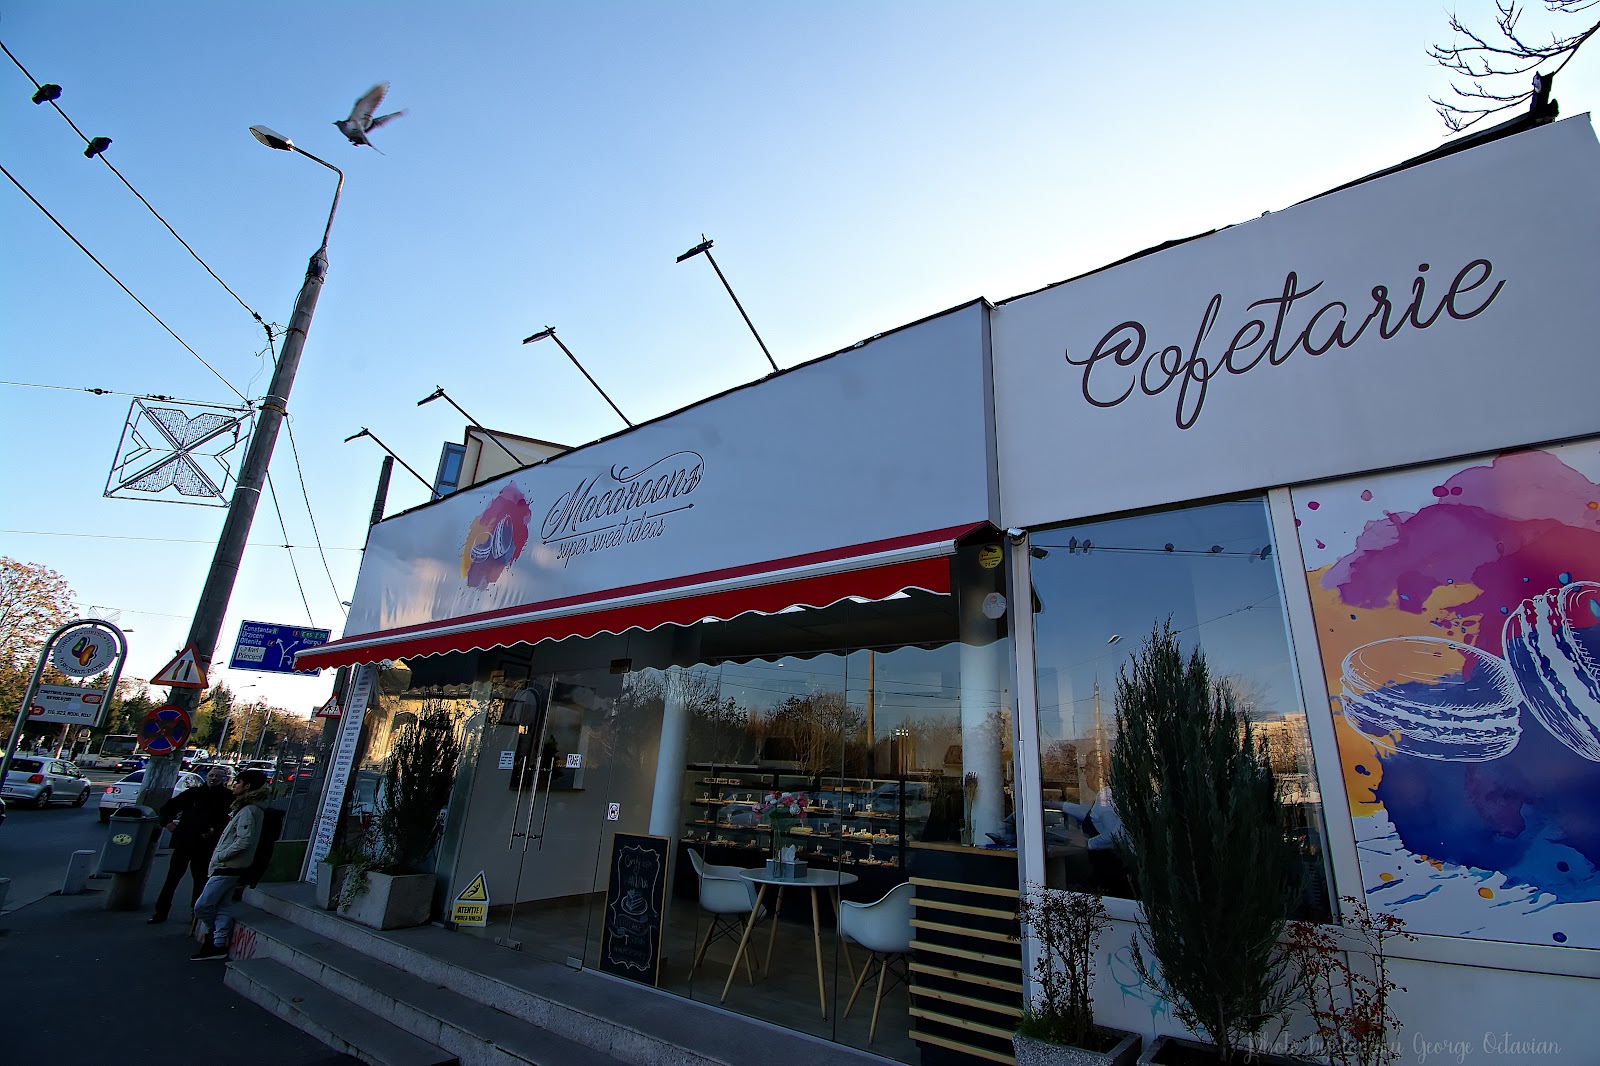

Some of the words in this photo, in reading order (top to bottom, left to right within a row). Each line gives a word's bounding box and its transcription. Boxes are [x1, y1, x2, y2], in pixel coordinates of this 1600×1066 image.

[1066, 258, 1507, 430] Cofetarie
[541, 451, 705, 539] Macaroons
[556, 537, 589, 568] super
[590, 516, 629, 552] sweet
[627, 511, 666, 543] ideas
